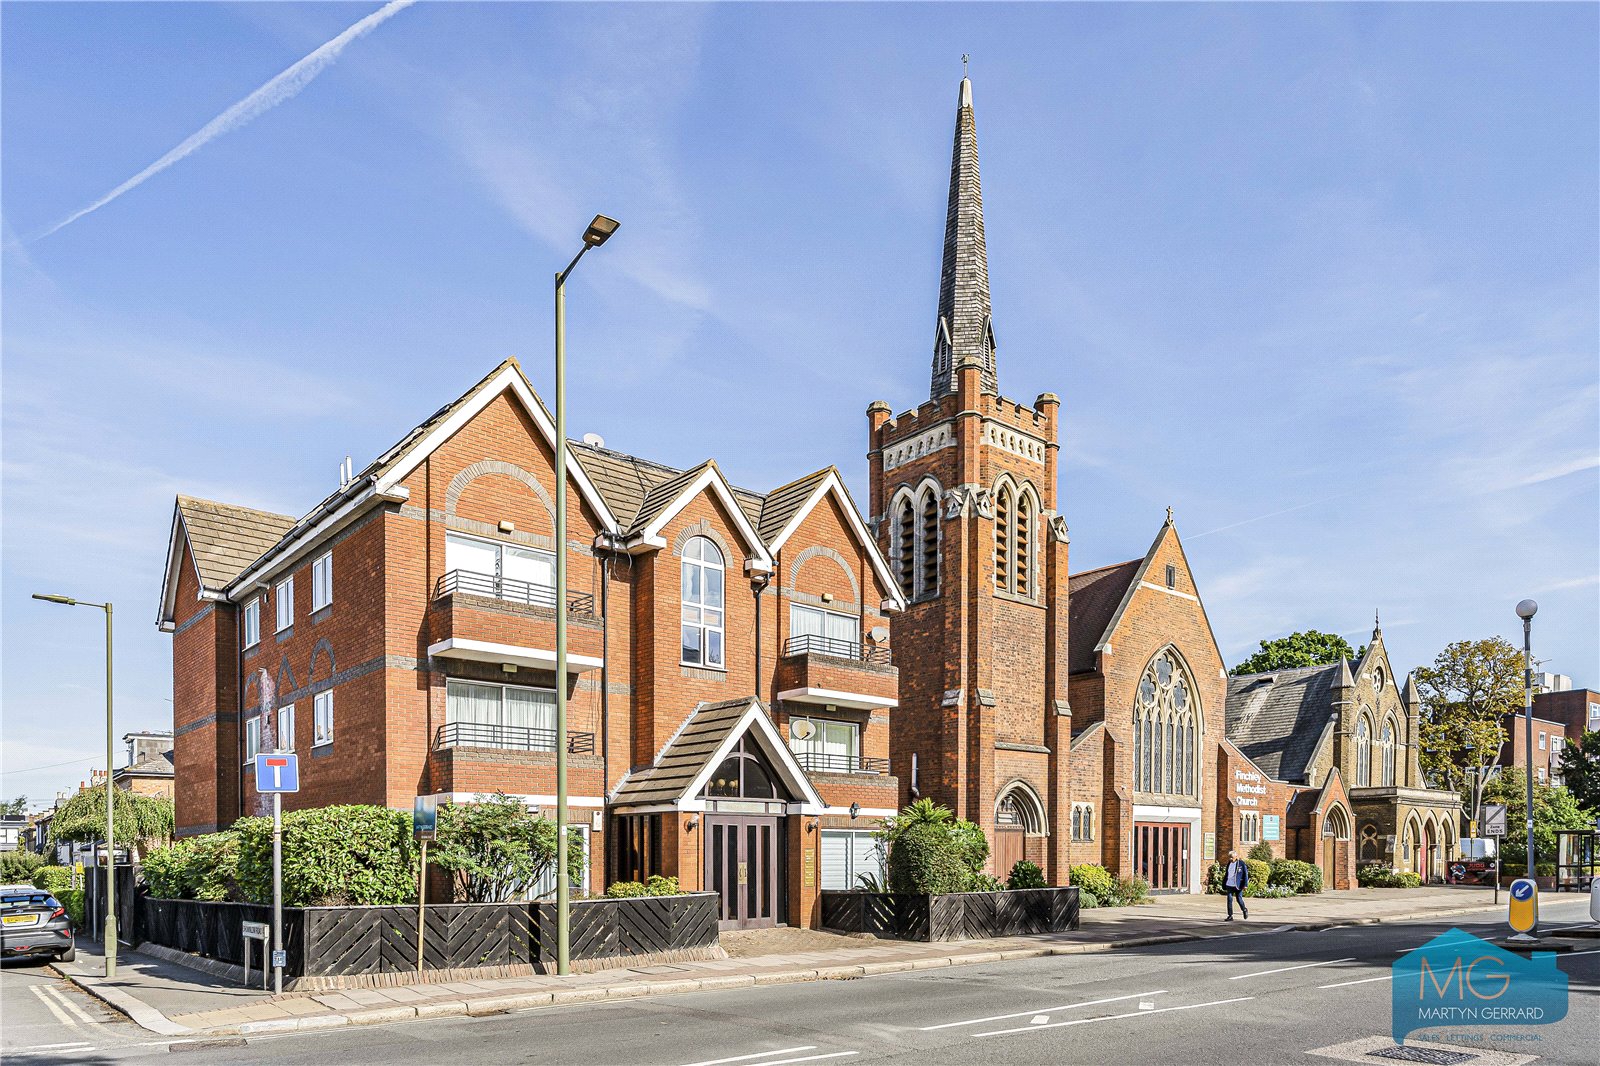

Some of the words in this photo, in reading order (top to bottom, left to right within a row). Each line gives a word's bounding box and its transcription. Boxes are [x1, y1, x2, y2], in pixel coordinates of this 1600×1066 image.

[1236, 770, 1261, 783] Finchley
[1236, 783, 1266, 794] Methodist
[1236, 796, 1258, 806] Church
